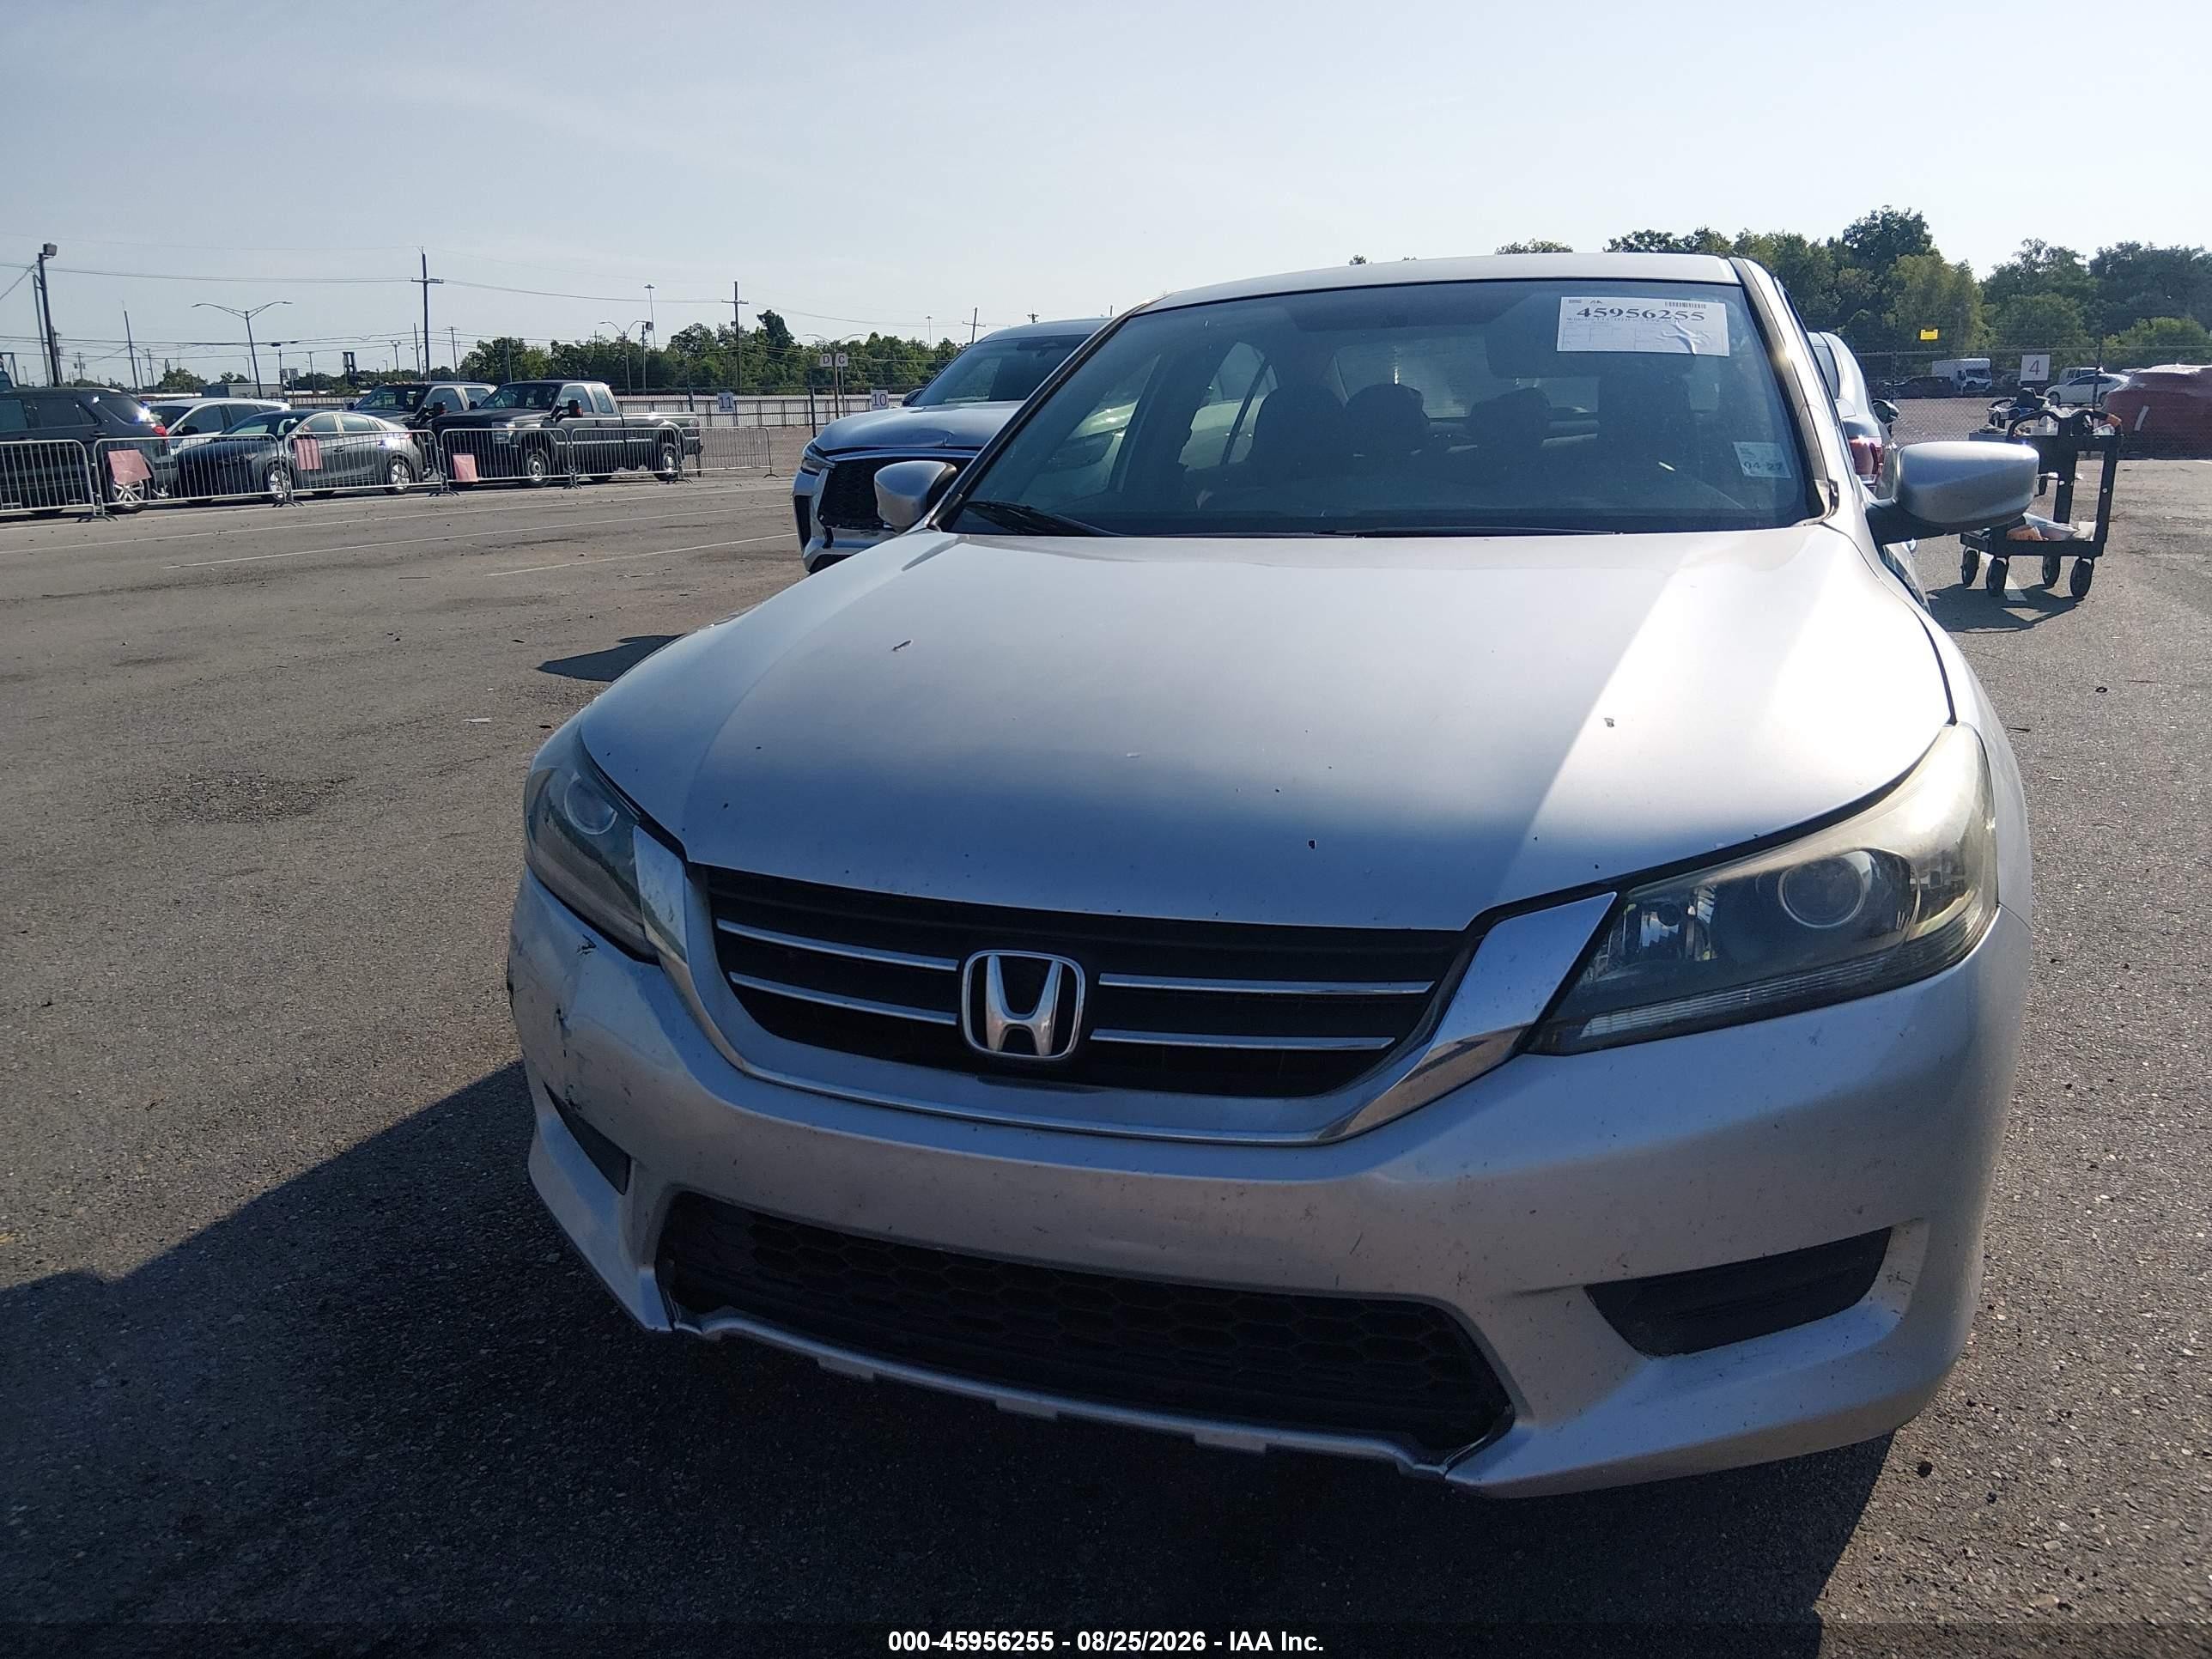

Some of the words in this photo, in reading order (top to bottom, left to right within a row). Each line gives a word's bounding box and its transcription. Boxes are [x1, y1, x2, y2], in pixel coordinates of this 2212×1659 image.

[1577, 307, 1706, 321] 45956255
[823, 355, 830, 364] D
[838, 355, 846, 364] C
[2028, 360, 2041, 375] 4
[719, 396, 733, 409] 11
[872, 393, 887, 406] 10
